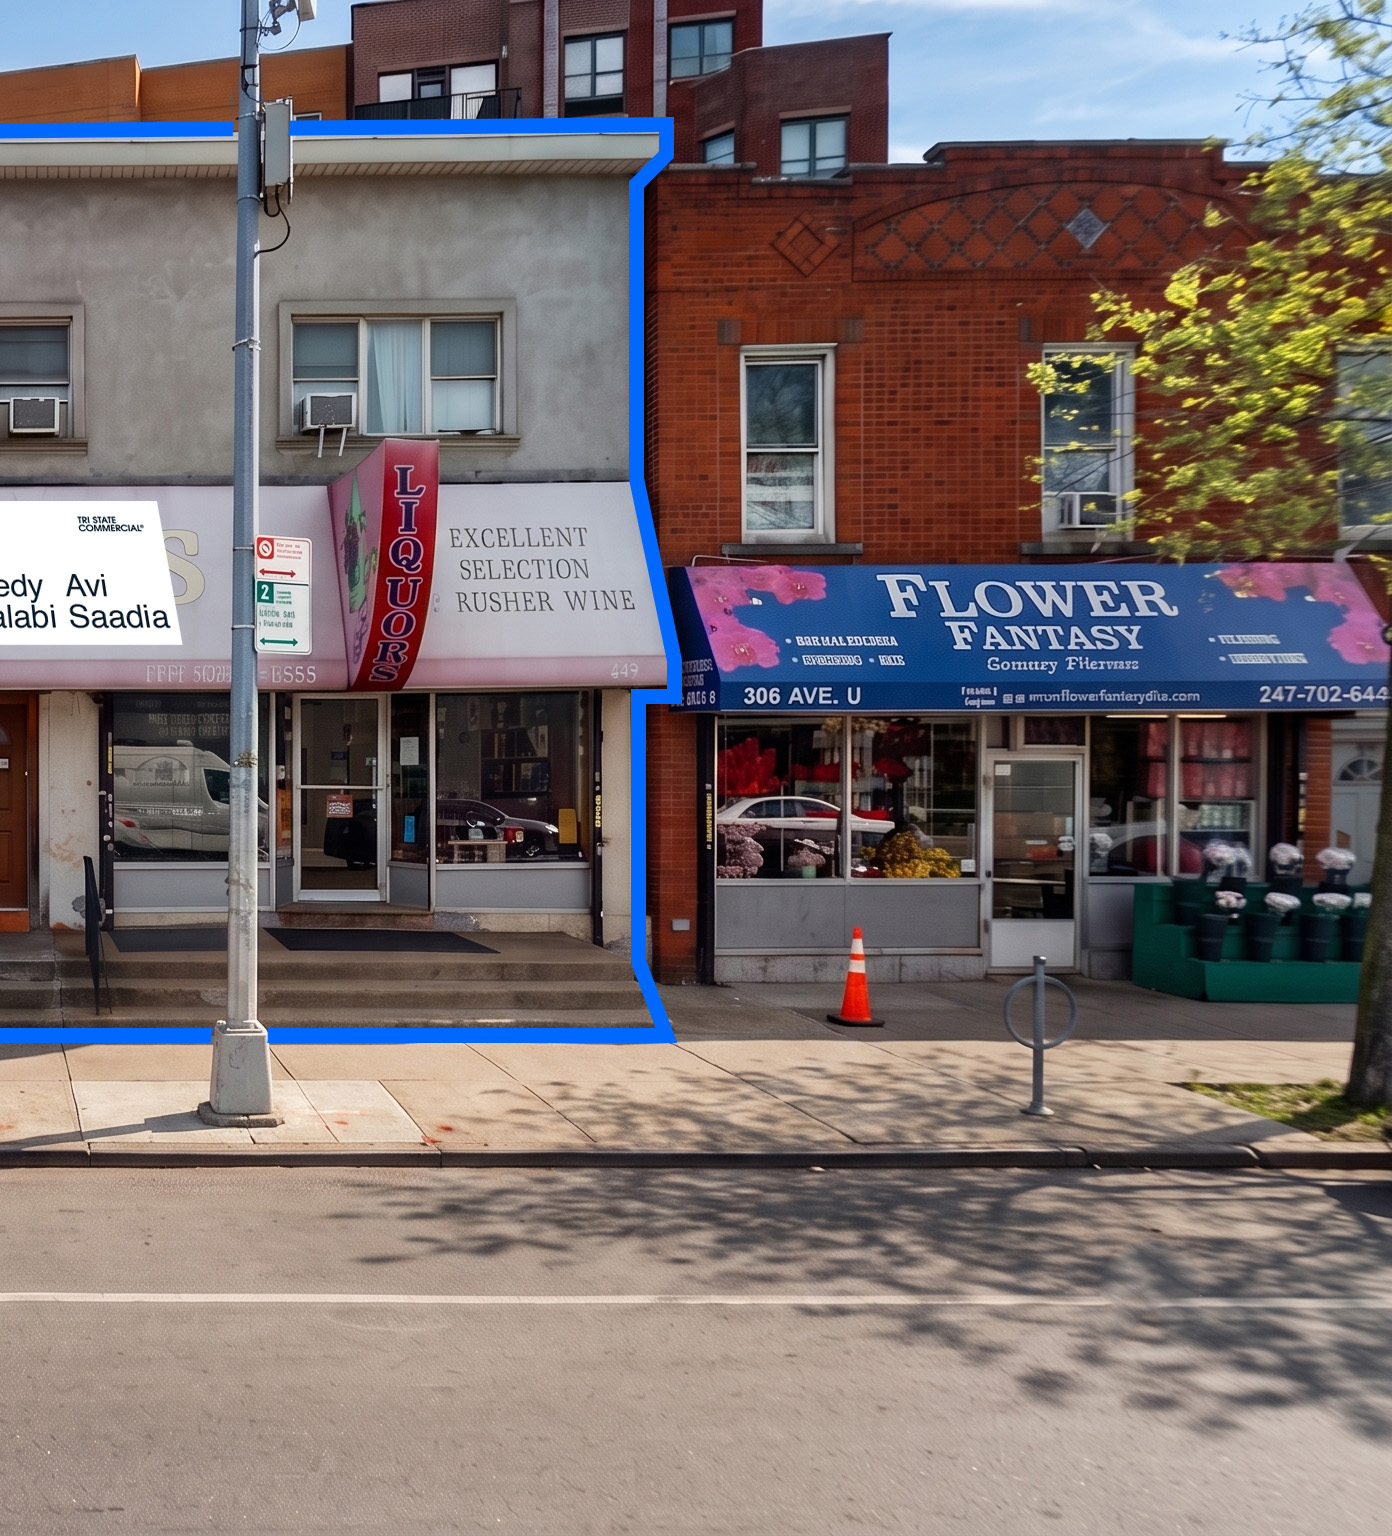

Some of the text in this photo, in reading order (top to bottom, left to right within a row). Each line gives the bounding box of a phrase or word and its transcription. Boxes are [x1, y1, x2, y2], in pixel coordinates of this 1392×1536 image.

[77, 516, 117, 524] TRI STATE
[449, 527, 588, 549] EXCELLENT
[369, 464, 427, 683] LIQUORS
[460, 558, 590, 581] SELECTION
[66, 573, 108, 597] Avi
[260, 584, 270, 600] 2
[876, 574, 1179, 618] FLOWER
[455, 589, 636, 613] RUSHER WINE
[69, 603, 171, 629] Saadia
[944, 621, 1144, 651] FANTASY
[744, 687, 861, 705] 306 AVE. U
